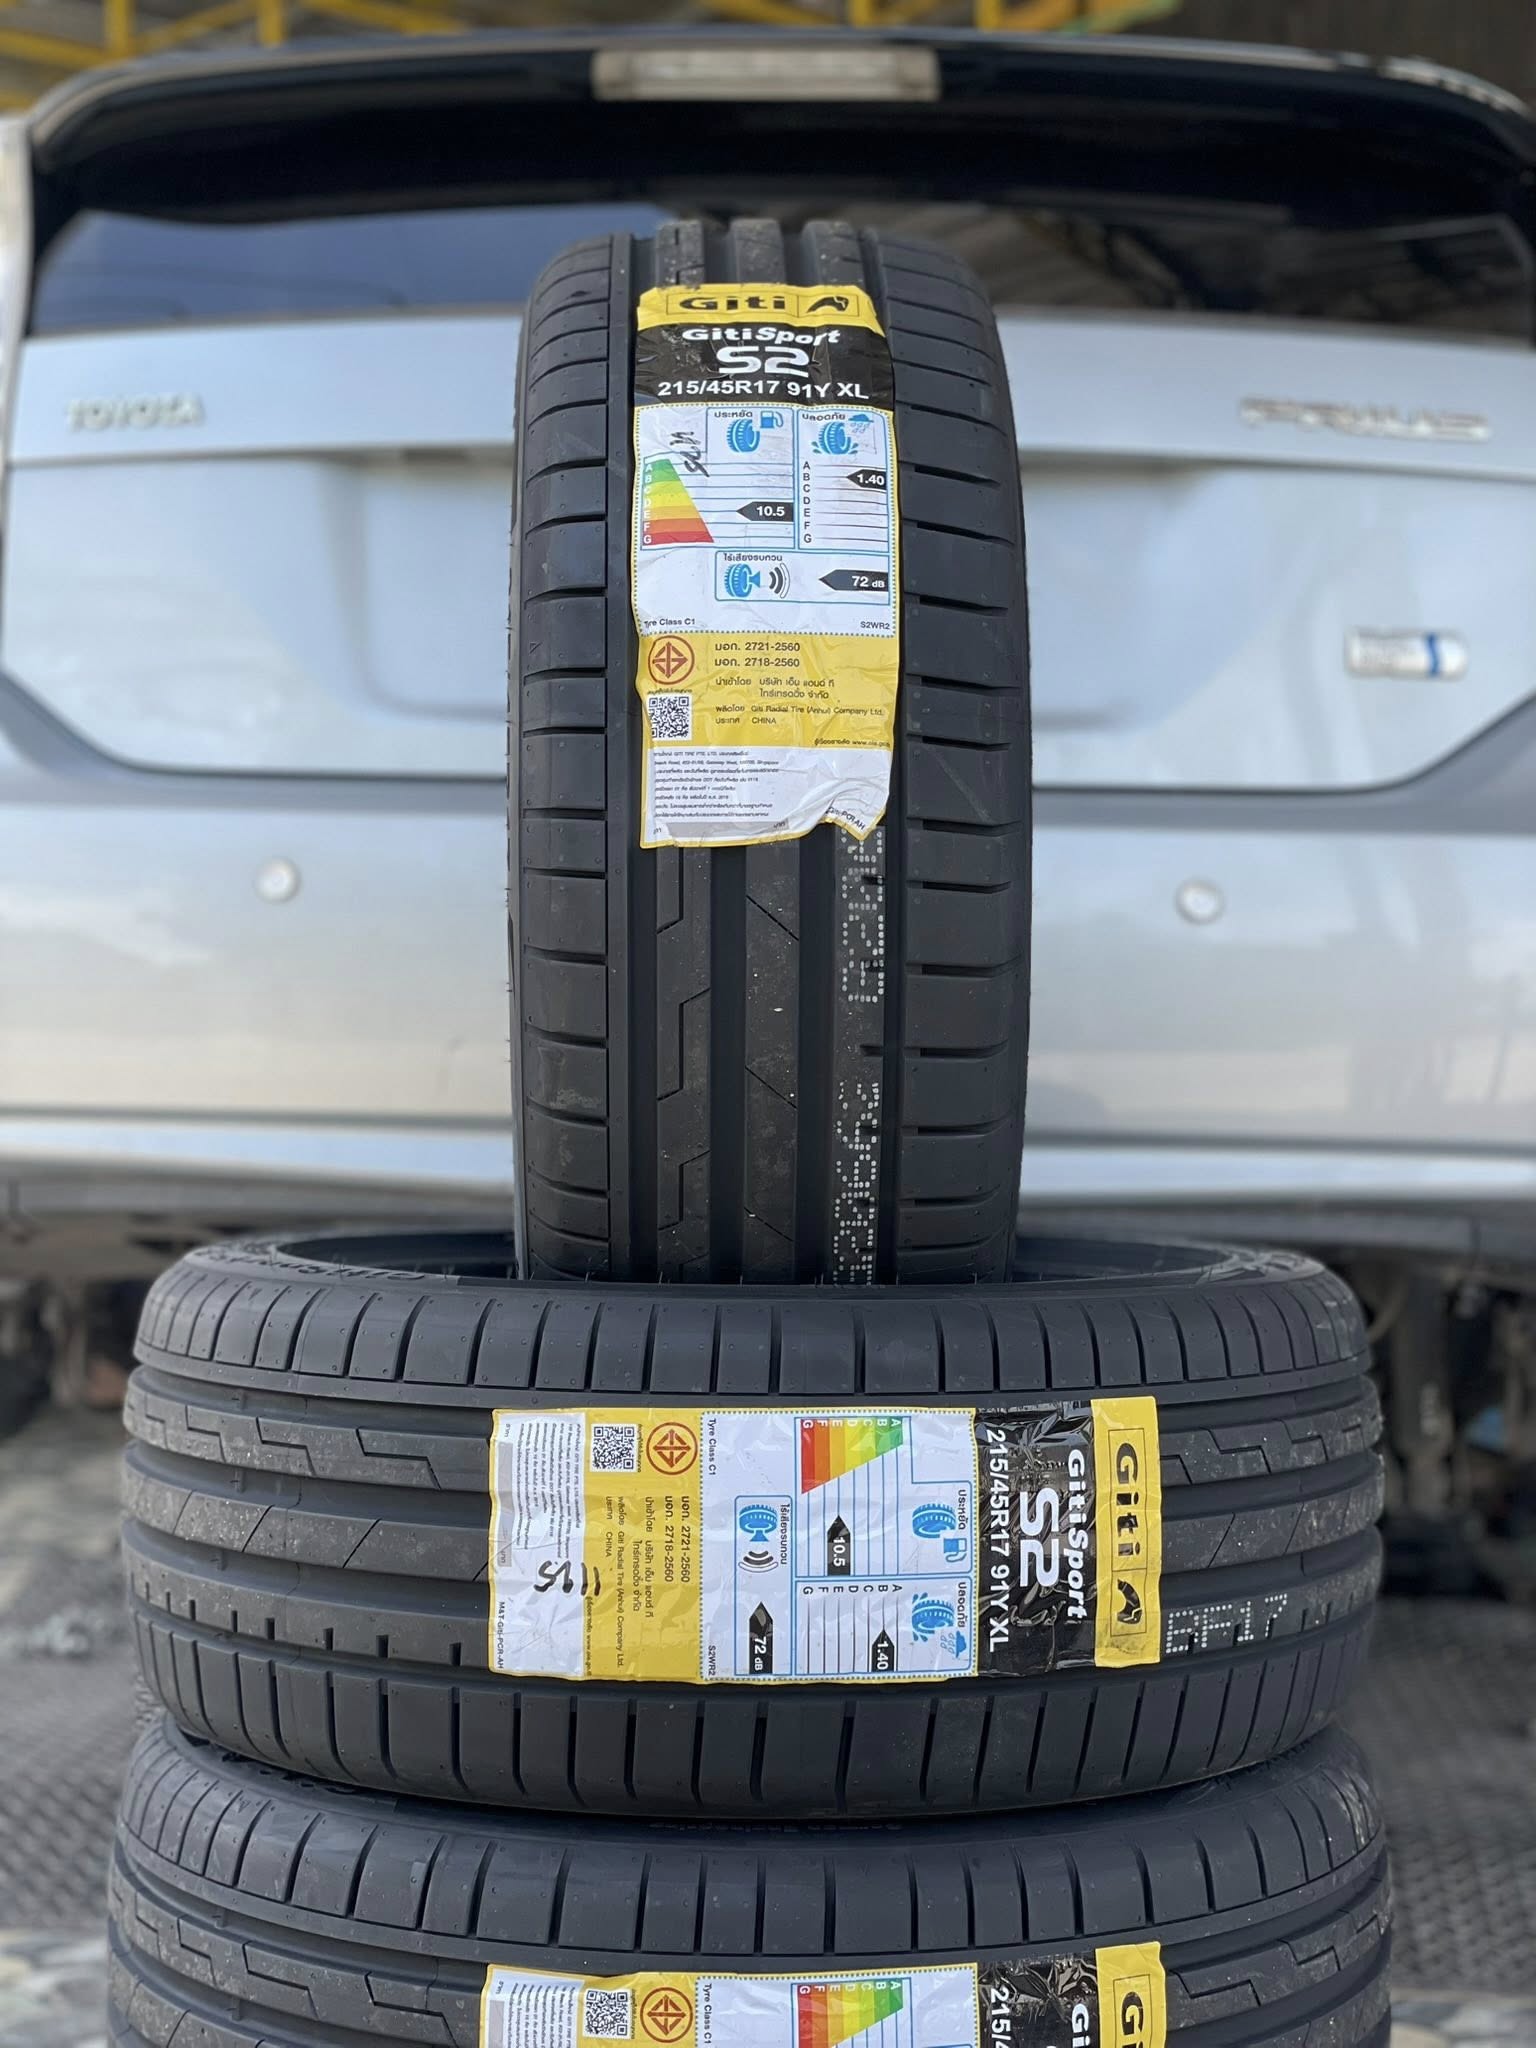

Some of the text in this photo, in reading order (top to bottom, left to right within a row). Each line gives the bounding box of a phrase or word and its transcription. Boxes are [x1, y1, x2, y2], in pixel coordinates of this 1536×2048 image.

[680, 296, 786, 311] Giti
[681, 327, 842, 347] GitiSport
[716, 345, 810, 378] S2
[657, 380, 870, 400] 215/45R17 91Y XL
[714, 410, 753, 419] ประหยัด
[802, 412, 846, 421] ปลอดภัย
[803, 461, 811, 470] A
[803, 473, 811, 482] B
[857, 473, 885, 486] 1.40
[803, 484, 811, 493] C
[803, 496, 811, 505] D
[756, 506, 785, 517] 10.5
[803, 509, 811, 517] E
[804, 521, 811, 530] F
[803, 534, 812, 544] G
[723, 553, 783, 562] ไร้เสียงรบกวน
[851, 575, 885, 588] 72 dB
[660, 618, 682, 626] Class
[860, 621, 891, 630] S2WR2
[715, 643, 801, 652] มอก. 2721-2560
[714, 658, 800, 668] มอก. 2718-2560
[833, 706, 868, 716] Company
[751, 717, 777, 725] CHINA
[708, 1418, 717, 1476] Tyre Class C1
[1116, 1442, 1141, 1557] Giti
[957, 1489, 967, 1531] ประหยัด
[617, 1531, 625, 1545] Giti
[664, 1496, 674, 1583] มอก. 2718-2560
[681, 1496, 690, 1583] มอก. 2721-2560
[780, 1503, 790, 1566] ไร้เสียงรบกวน
[986, 1429, 1010, 1653] 215/45R17 91Y XL
[1019, 1487, 1060, 1588] S2
[1063, 1449, 1089, 1620] GitiSport
[605, 1531, 613, 1558] CHINA
[832, 1536, 846, 1567] 10.5
[617, 1546, 625, 1570] Radial
[617, 1572, 625, 1586] Tire
[803, 1586, 814, 1595] G
[848, 1585, 858, 1593] D
[863, 1585, 873, 1593] C
[878, 1584, 888, 1593] B
[892, 1584, 903, 1592] A
[957, 1582, 967, 1628] ปลอดภัย
[615, 1615, 624, 1652] Company
[754, 1636, 767, 1671] 72 dB
[876, 1640, 889, 1670] 1.40
[617, 1653, 625, 1669] Ltd.
[707, 1645, 716, 1677] S2WR2
[704, 1983, 713, 2045] Tyre Class C1
